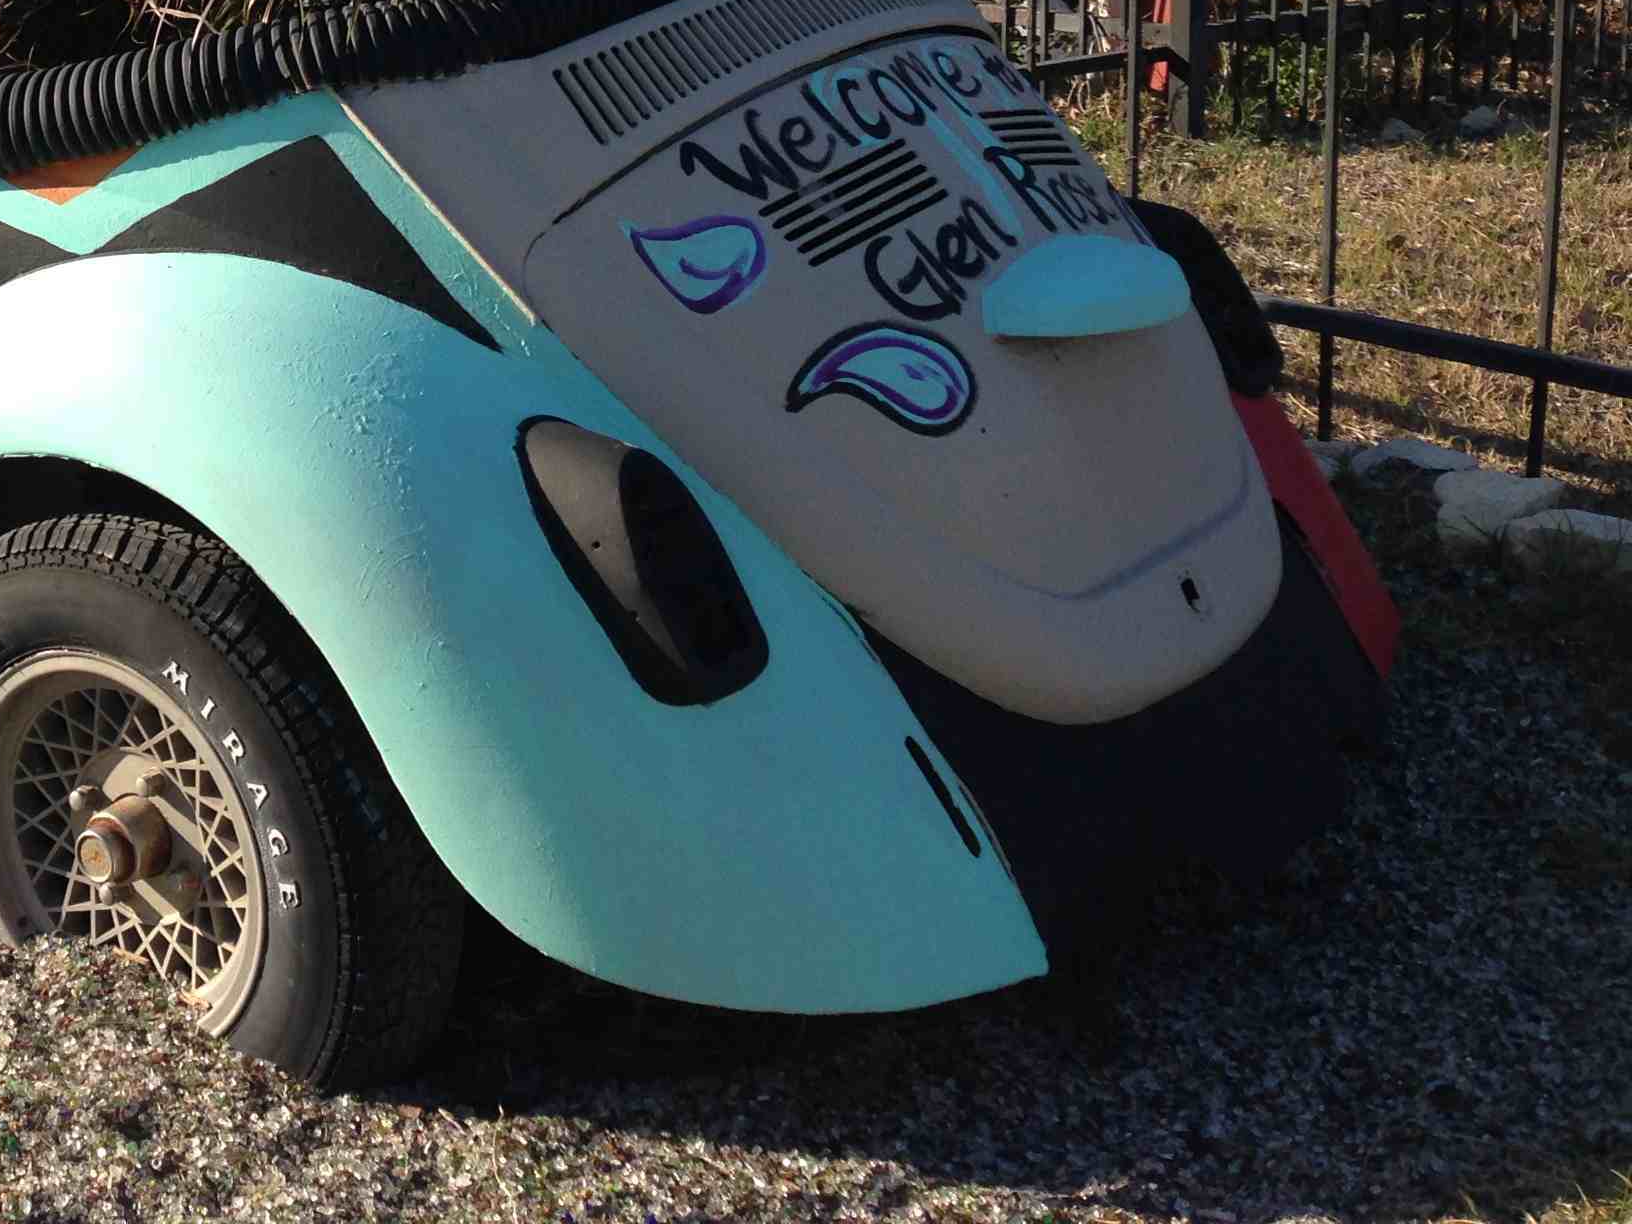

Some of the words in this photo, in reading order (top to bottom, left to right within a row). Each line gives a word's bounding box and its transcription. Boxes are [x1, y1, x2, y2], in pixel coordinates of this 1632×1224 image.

[679, 46, 982, 201] Welcome
[865, 196, 1018, 321] Glen
[161, 659, 302, 911] MIRAGE
